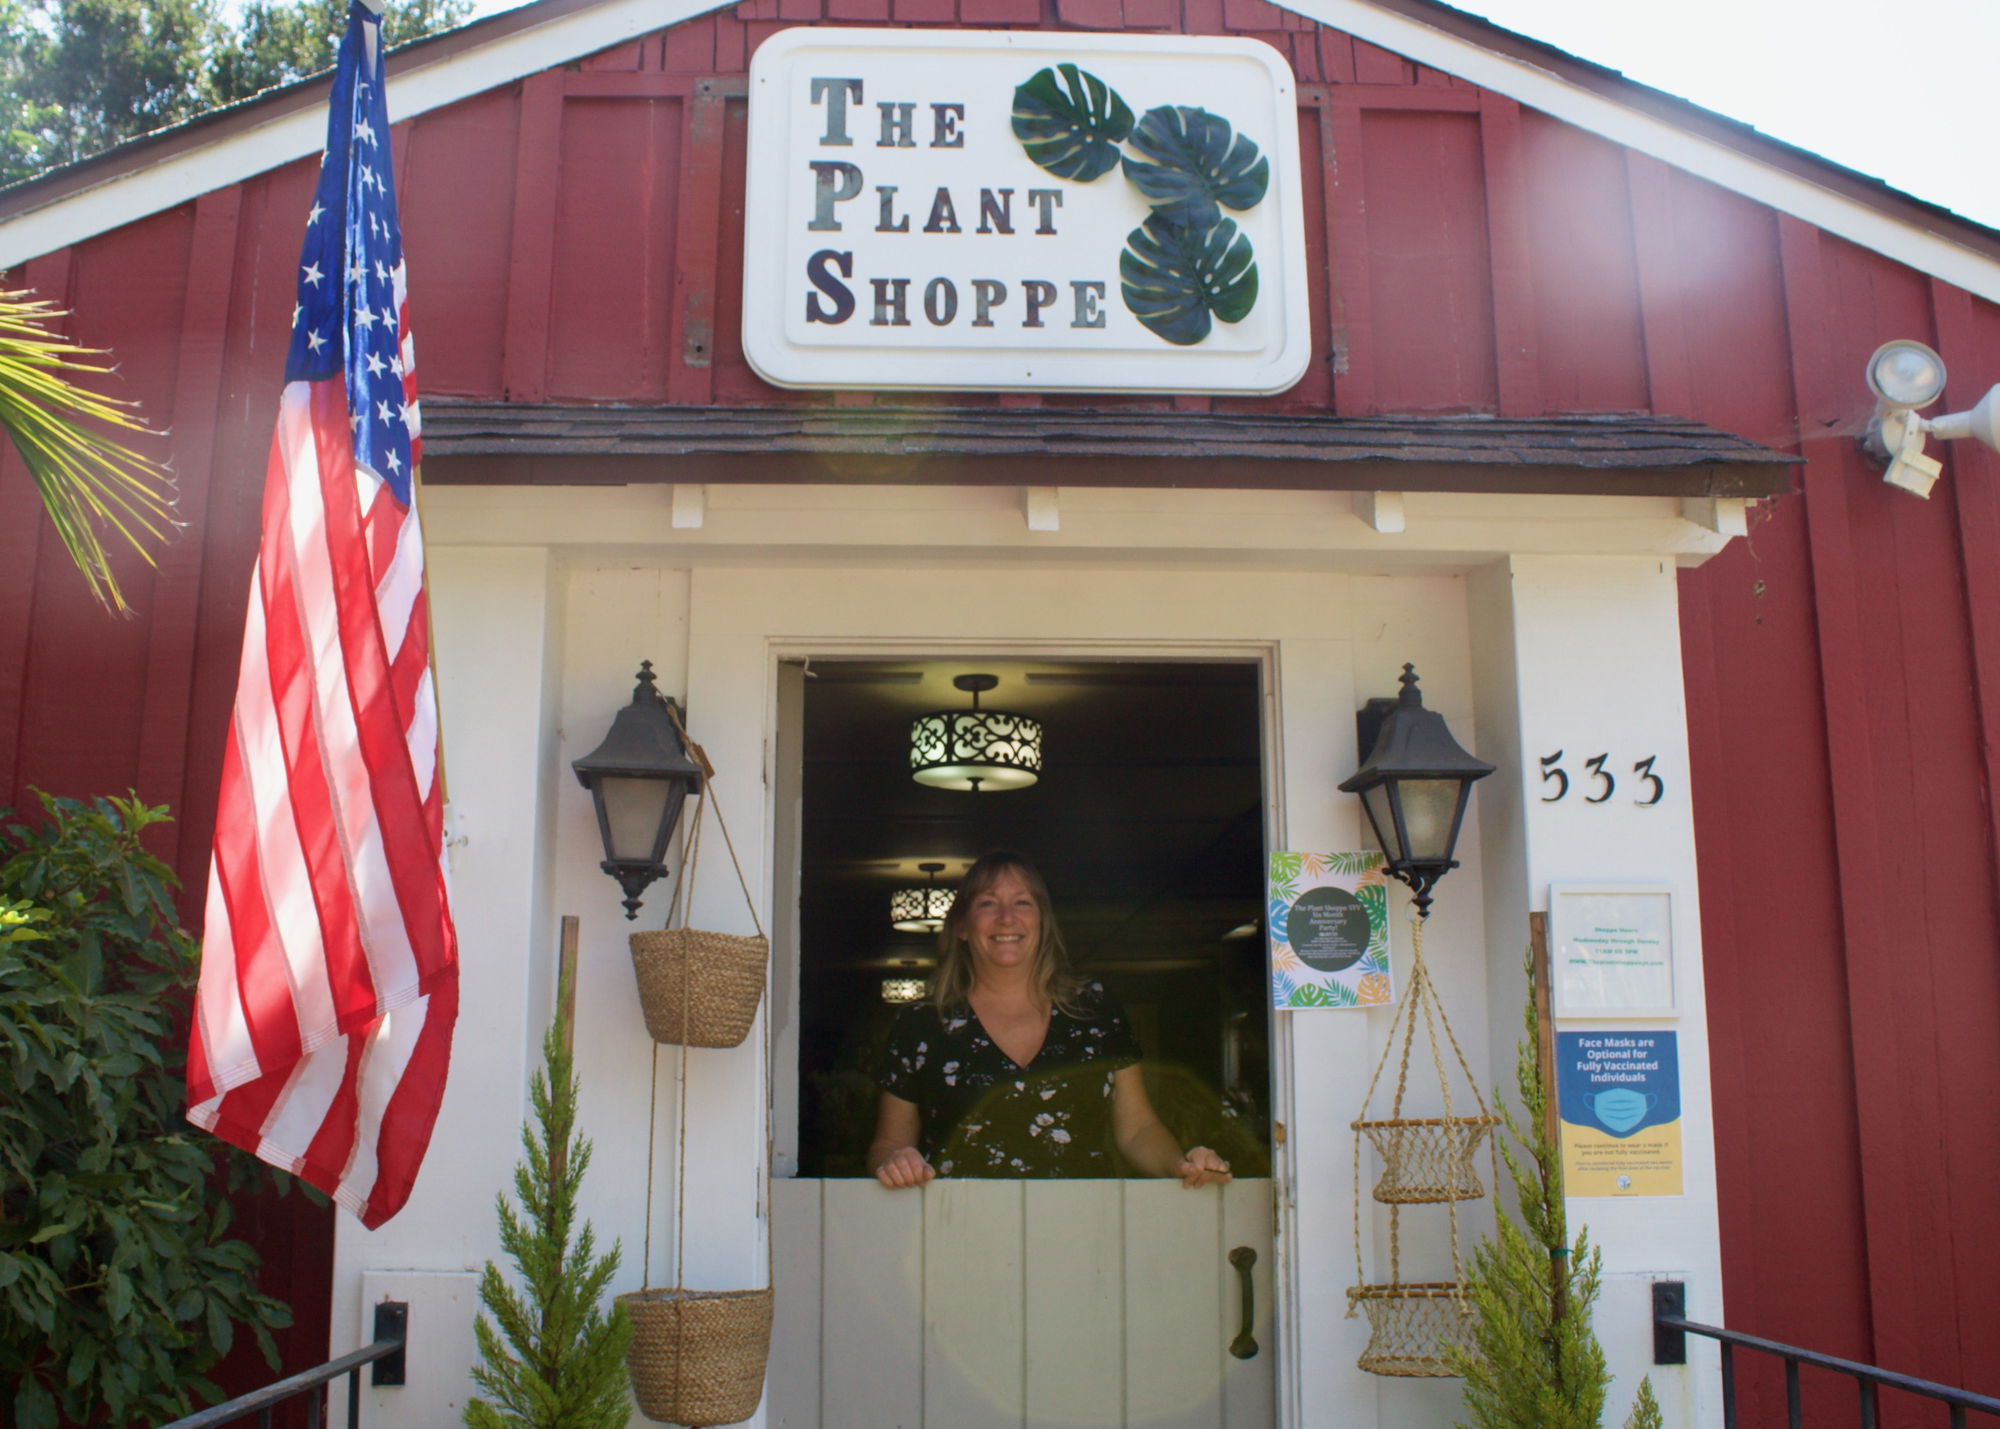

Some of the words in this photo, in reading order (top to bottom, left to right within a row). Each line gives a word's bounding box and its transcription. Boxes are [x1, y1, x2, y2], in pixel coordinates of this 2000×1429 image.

[810, 77, 966, 149] THE
[807, 160, 1064, 235] PLANT
[806, 249, 1106, 329] SHOPPE
[1539, 749, 1665, 807] 533
[1578, 1037, 1603, 1048] Face
[1604, 1036, 1637, 1048] Masks
[1637, 1038, 1656, 1048] are
[1586, 1049, 1631, 1061] Optional
[1631, 1048, 1649, 1059] for
[1576, 1061, 1603, 1073] Fully
[1603, 1059, 1659, 1071] Vaccinated
[1590, 1071, 1647, 1083] Individuals
